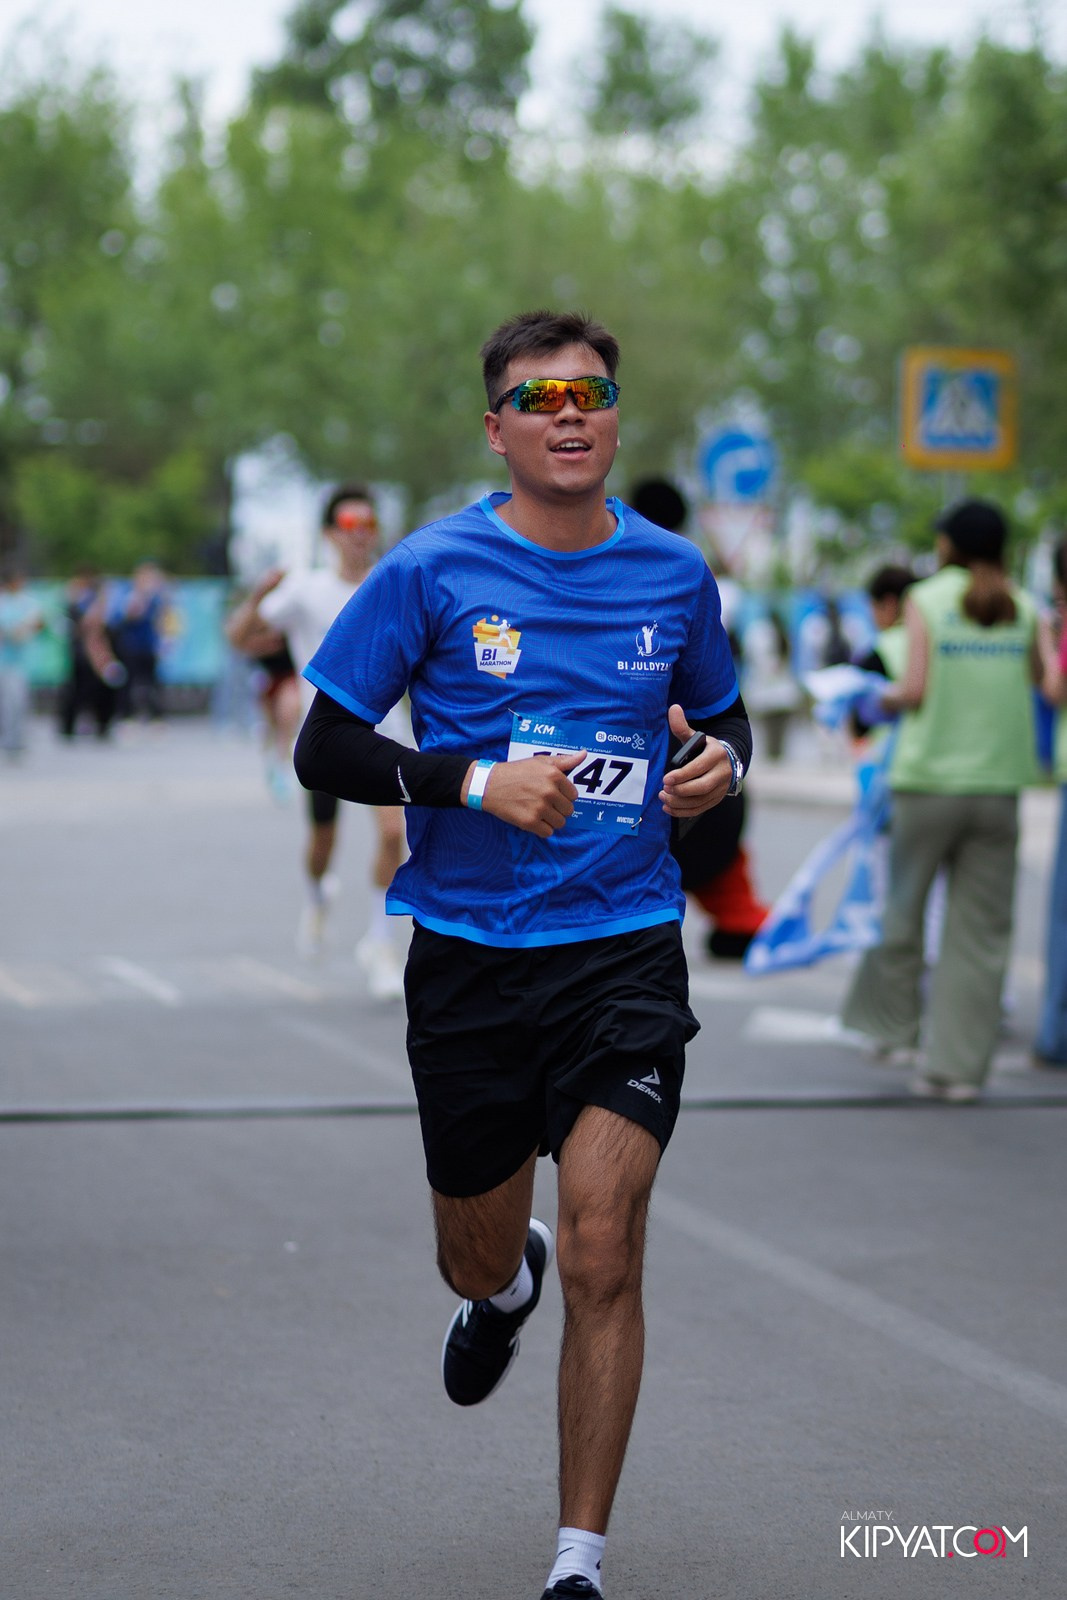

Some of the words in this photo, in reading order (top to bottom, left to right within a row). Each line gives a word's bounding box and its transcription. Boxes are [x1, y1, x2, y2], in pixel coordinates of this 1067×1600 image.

[482, 648, 497, 661] BI
[617, 661, 628, 670] BI
[519, 719, 532, 732] 5
[533, 724, 555, 735] KM
[607, 734, 632, 744] GROUP
[627, 1079, 662, 1104] DEMIX
